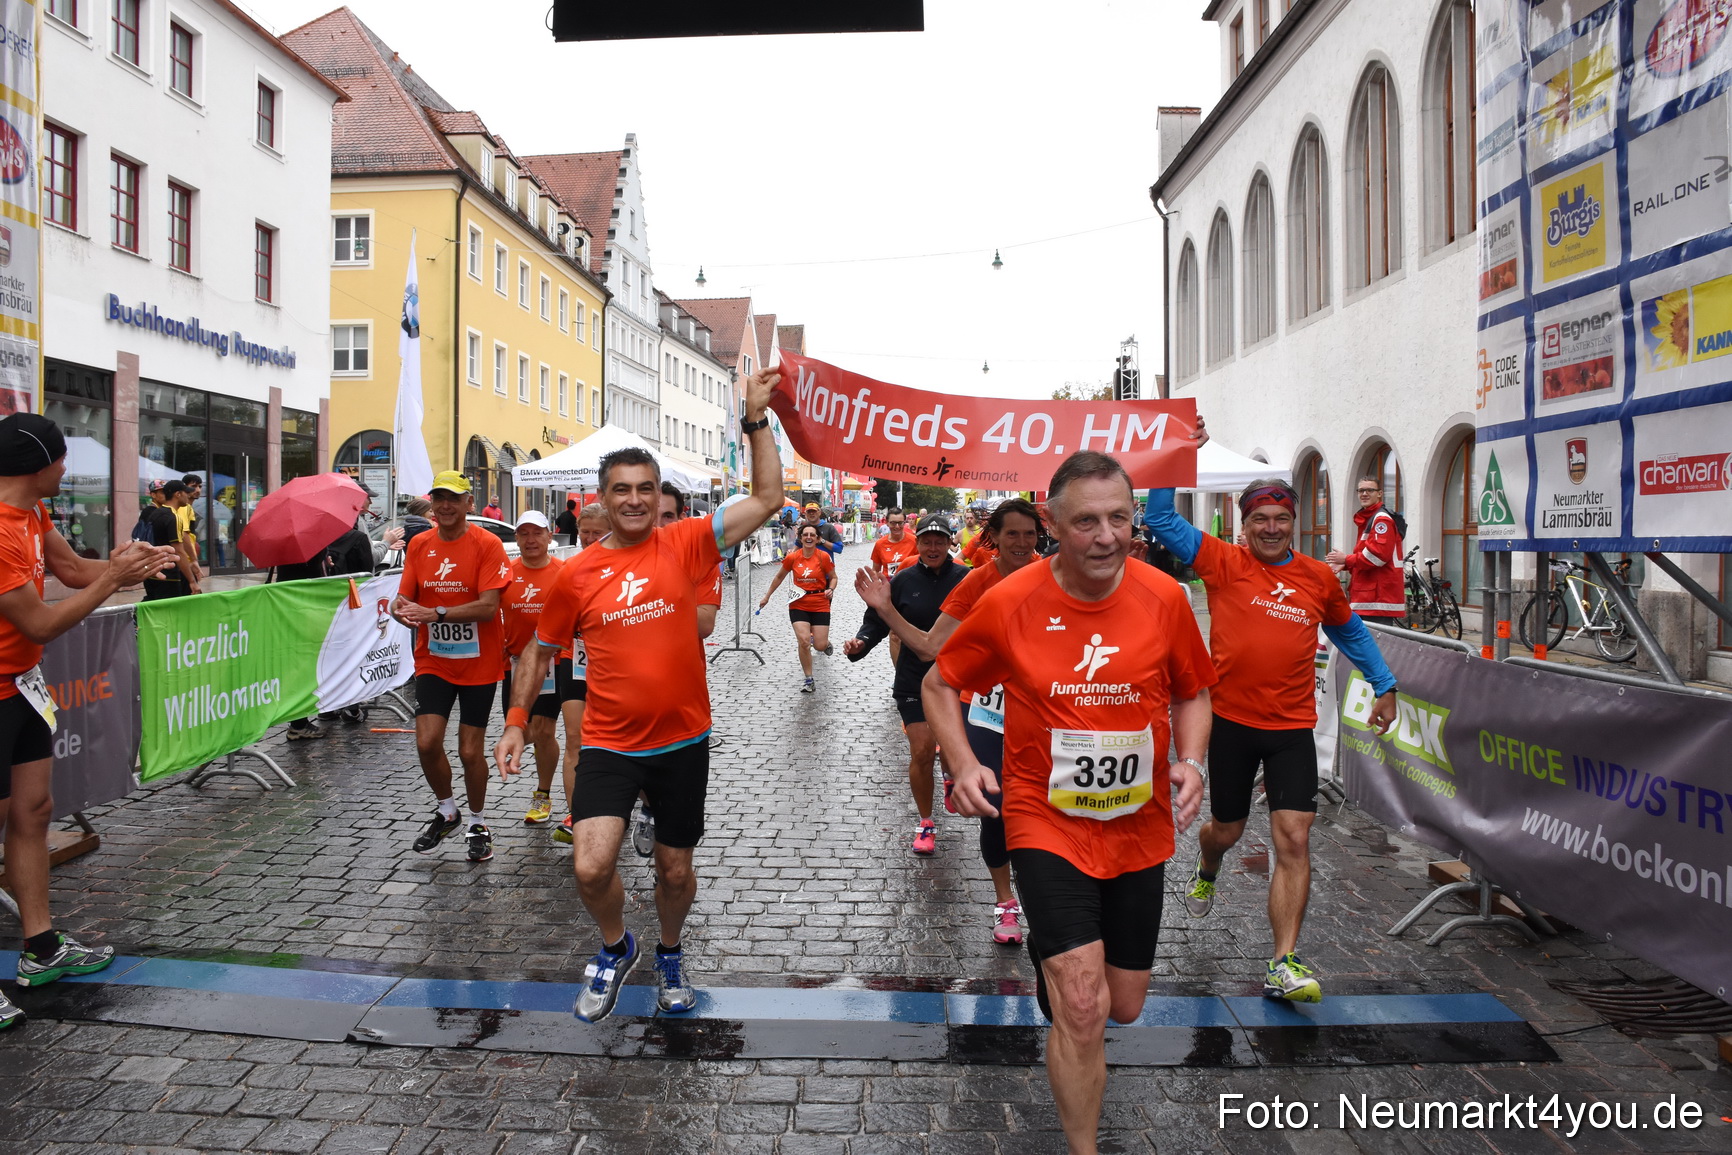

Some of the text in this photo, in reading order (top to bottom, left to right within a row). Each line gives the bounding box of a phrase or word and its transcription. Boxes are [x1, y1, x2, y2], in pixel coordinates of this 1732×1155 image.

[1633, 172, 1710, 216] RAIL.ONE
[1547, 196, 1600, 247] Burgis
[106, 293, 296, 369] Buchhandlung Rupprecht
[1495, 354, 1517, 373] CODE
[1495, 370, 1521, 390] CLINIC
[794, 365, 1169, 455] Manfreds 40. HM
[861, 454, 1018, 484] funrunners neumarkt
[1644, 459, 1718, 486] charivari
[1553, 490, 1604, 507] Neumarkter
[1542, 507, 1612, 528] Lammsbräu
[424, 580, 462, 588] funrunners
[602, 598, 664, 625] funrunners
[623, 603, 675, 627] neumarkt
[1250, 596, 1306, 616] funrunners
[1266, 609, 1310, 626] neumarkt
[431, 623, 474, 641] 3085
[166, 619, 249, 672] Herzlich
[1049, 681, 1131, 697] funrunners
[1075, 692, 1141, 706] neumarkt
[164, 677, 280, 735] Willkommen
[1061, 740, 1095, 749] NeuerMarkt
[1479, 729, 1566, 785] OFFICE
[1074, 753, 1139, 788] 330
[1373, 740, 1387, 766] by
[1407, 766, 1457, 799] concepts
[1075, 792, 1130, 809] Manfred
